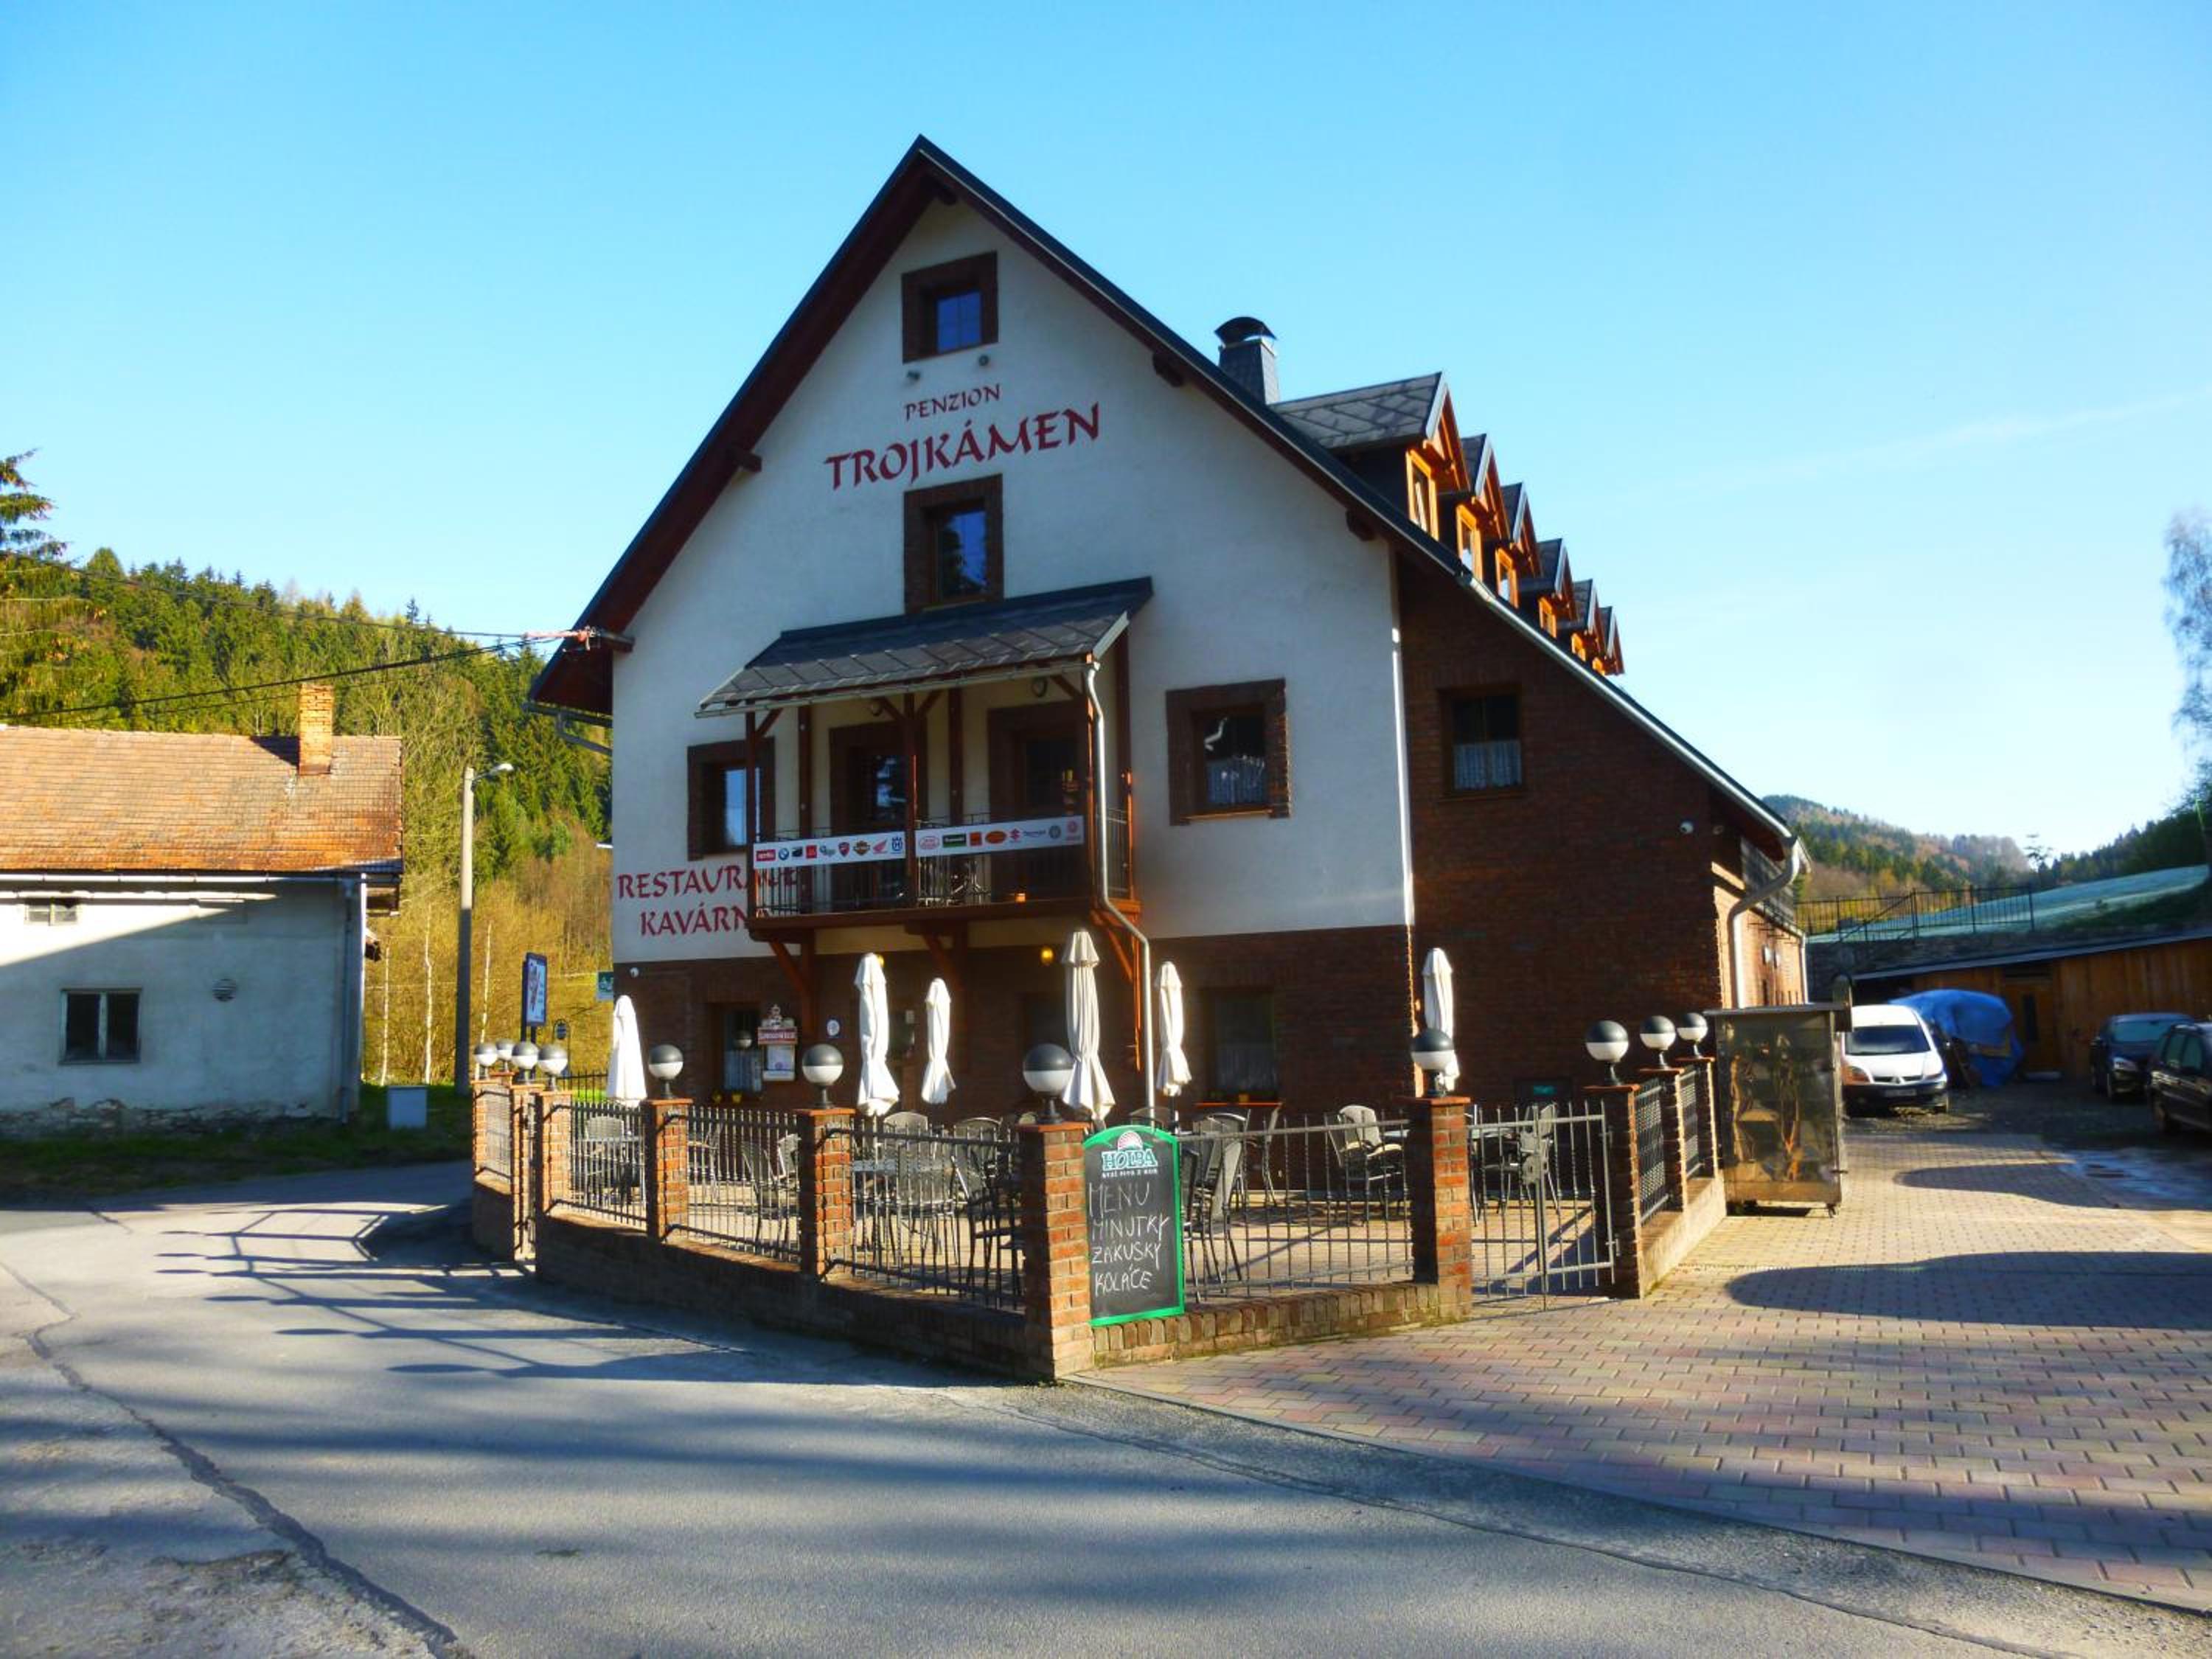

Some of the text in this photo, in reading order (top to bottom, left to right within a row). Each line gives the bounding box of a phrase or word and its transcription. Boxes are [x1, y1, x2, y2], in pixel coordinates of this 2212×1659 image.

[904, 383, 1001, 421] PENZION
[824, 401, 1099, 490] TROJKÁMEN
[640, 902, 748, 936] KAVÁRN
[1102, 1148, 1158, 1171] HOLBA
[1088, 1181, 1150, 1218] MENU
